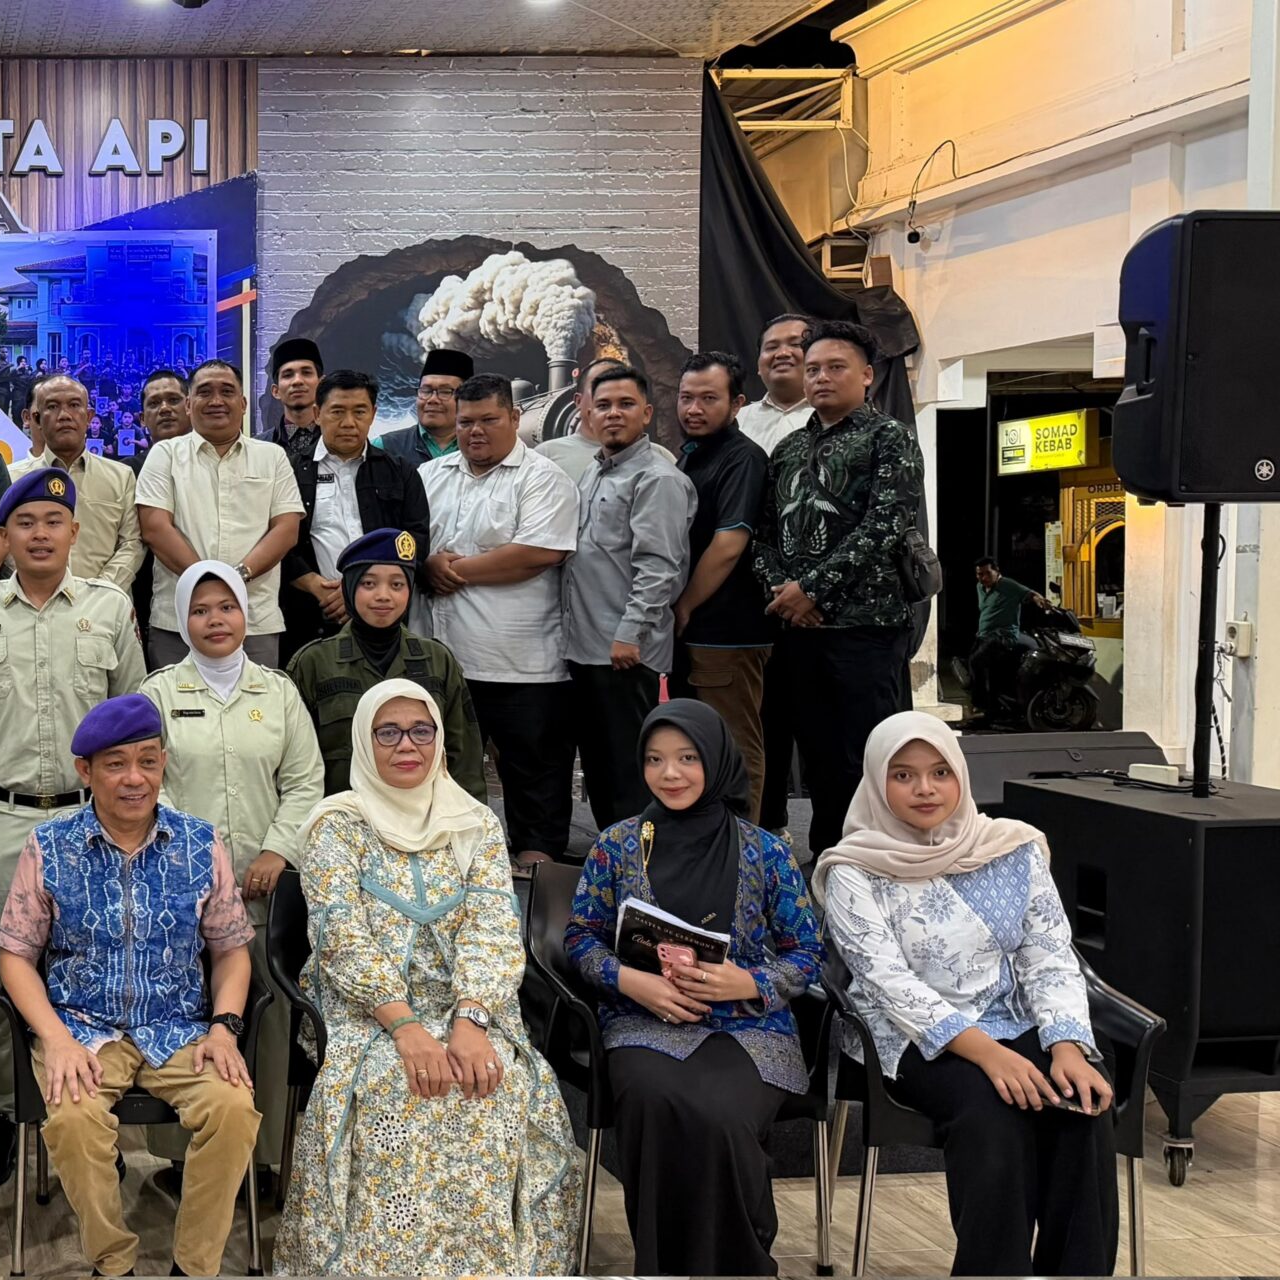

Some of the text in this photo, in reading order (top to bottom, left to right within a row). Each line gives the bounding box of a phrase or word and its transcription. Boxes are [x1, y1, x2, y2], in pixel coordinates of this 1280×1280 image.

[90, 117, 209, 176] API
[1035, 423, 1078, 441] SOMAD
[1035, 438, 1073, 453] KEBAB
